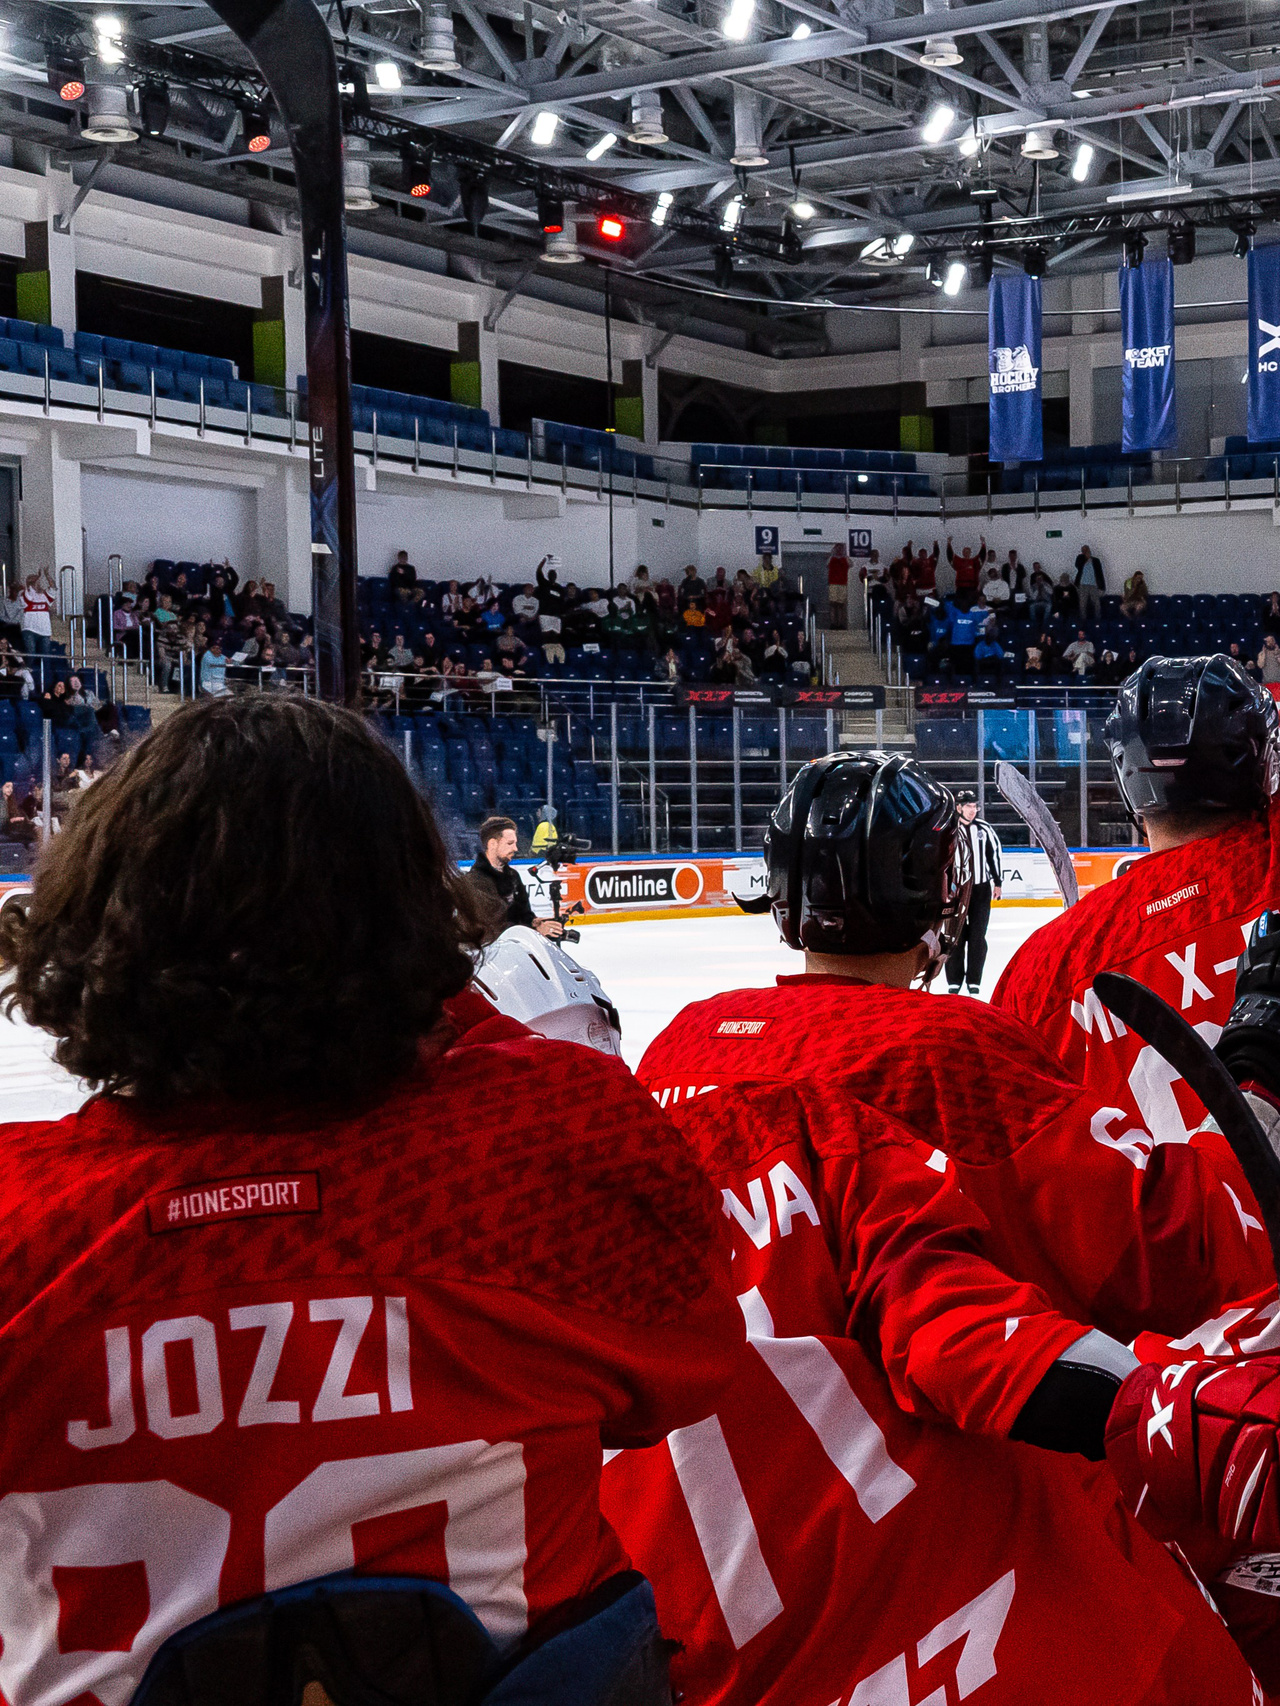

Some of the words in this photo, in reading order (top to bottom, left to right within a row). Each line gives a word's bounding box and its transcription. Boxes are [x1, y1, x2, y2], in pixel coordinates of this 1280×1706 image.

[1130, 357, 1165, 369] TEAM
[1258, 362, 1278, 373] HC
[990, 367, 1040, 387] HOCKEY
[992, 381, 1037, 394] BROTHERS
[313, 425, 324, 479] LITE
[761, 528, 773, 545] 9
[850, 531, 870, 547] 10
[685, 690, 732, 702] X17
[795, 691, 843, 703] X17
[920, 692, 966, 704] X17
[595, 875, 668, 899] Winline
[1145, 884, 1201, 916] #IONESPORT
[717, 1020, 767, 1035] #IONESPORT
[166, 1181, 301, 1223] #IONESPORT
[66, 1296, 414, 1451] JOZZI
